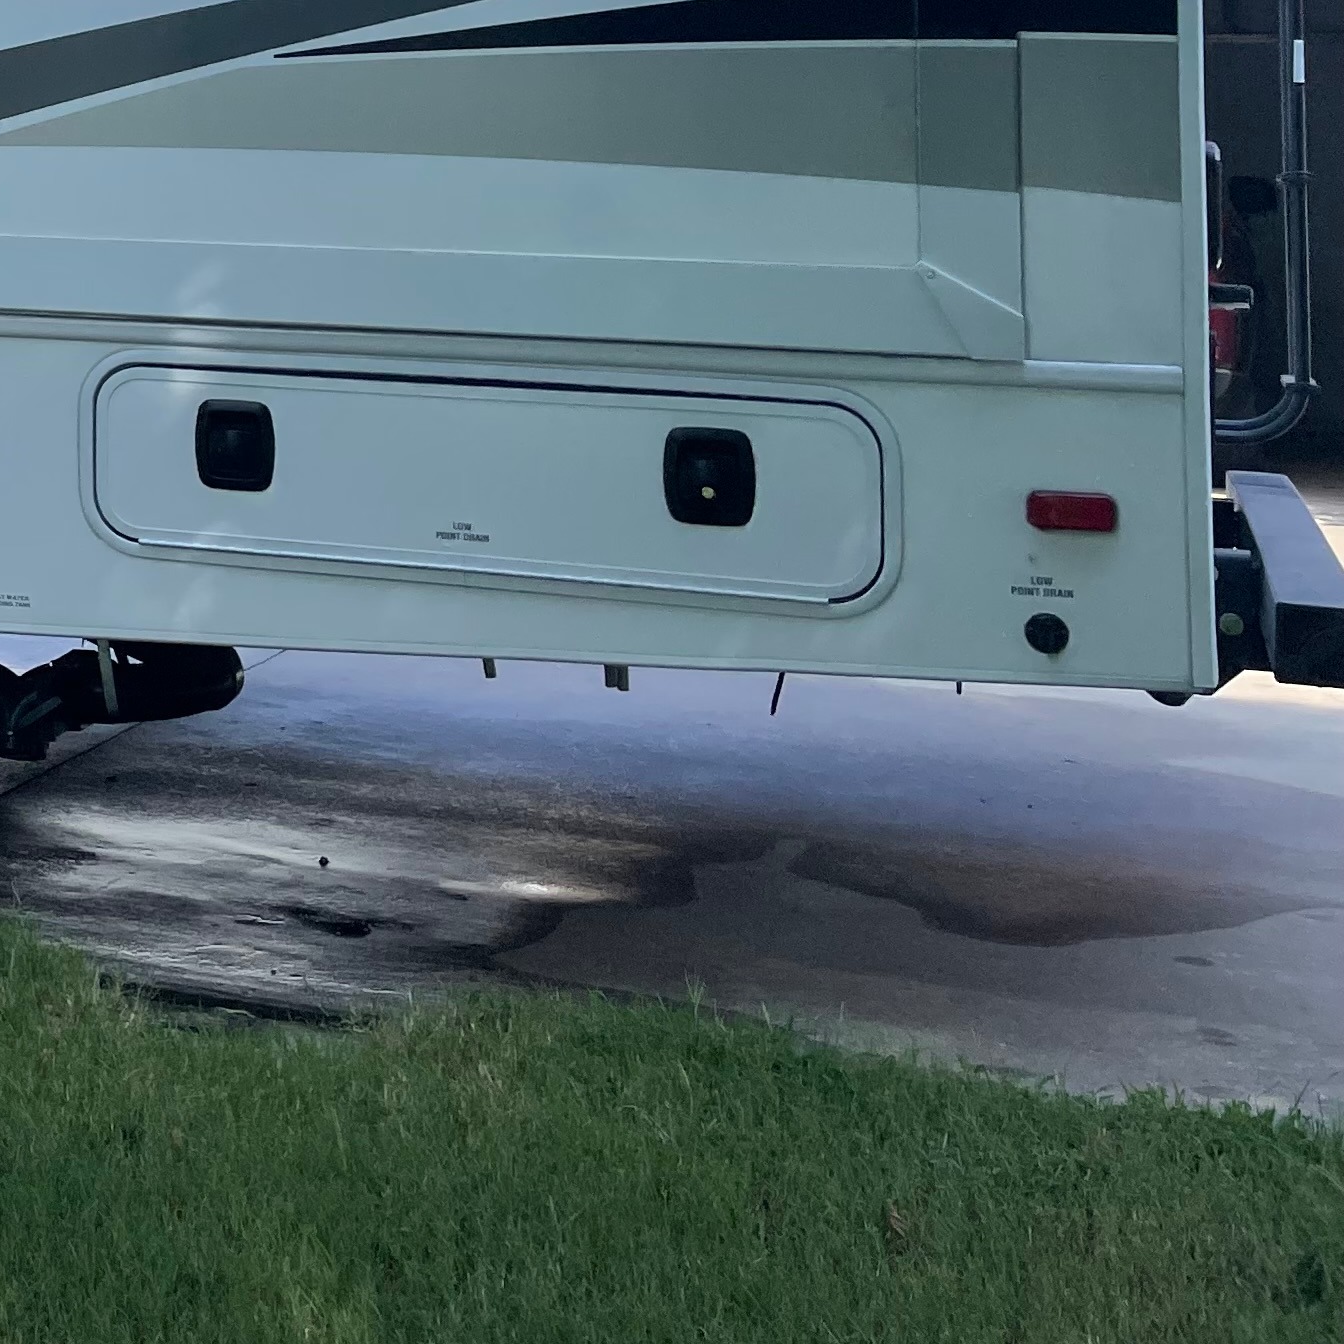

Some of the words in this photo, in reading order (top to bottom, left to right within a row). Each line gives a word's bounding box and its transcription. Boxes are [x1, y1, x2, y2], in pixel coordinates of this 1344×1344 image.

[452, 521, 472, 530] LOW
[1030, 576, 1053, 586] LOW
[1011, 585, 1040, 596] POINT
[1042, 587, 1074, 598] DRAIN
